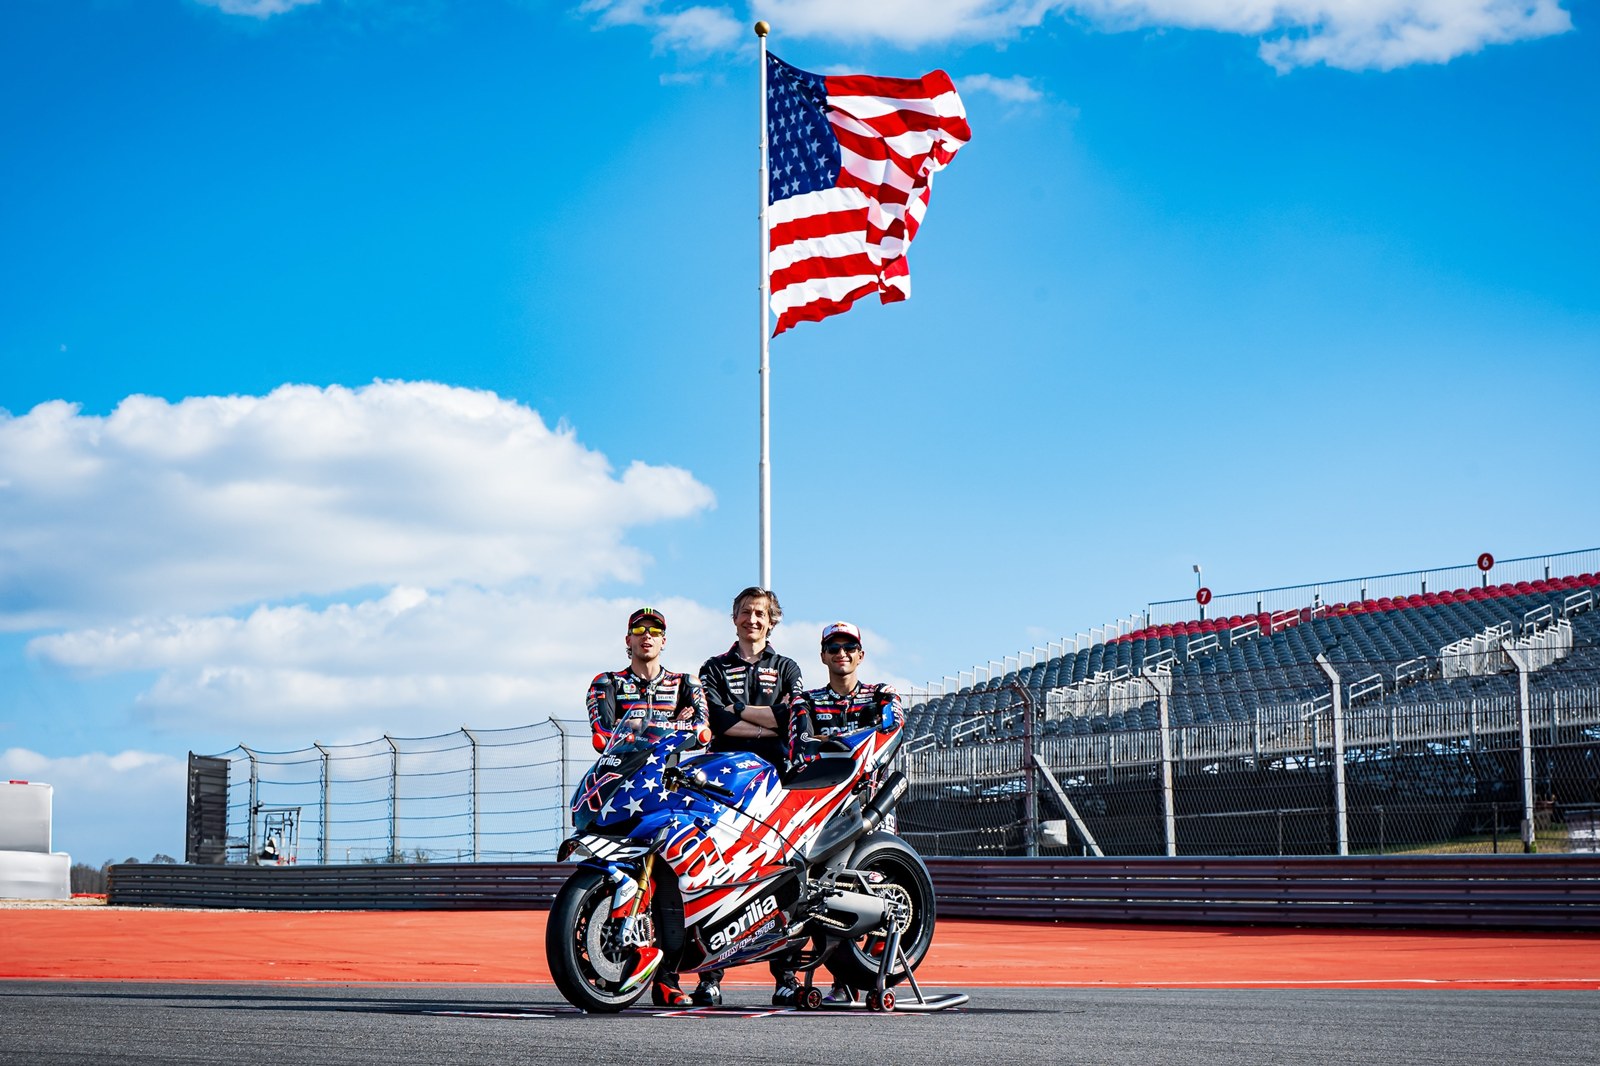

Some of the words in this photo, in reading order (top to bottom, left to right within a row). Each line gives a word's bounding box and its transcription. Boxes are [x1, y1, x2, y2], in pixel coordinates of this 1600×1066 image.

[1482, 556, 1489, 567] 6
[1200, 591, 1208, 602] 7
[655, 720, 693, 730] aprilia
[597, 754, 622, 768] prilia
[710, 894, 778, 950] aprilia
[732, 908, 780, 942] RACING
